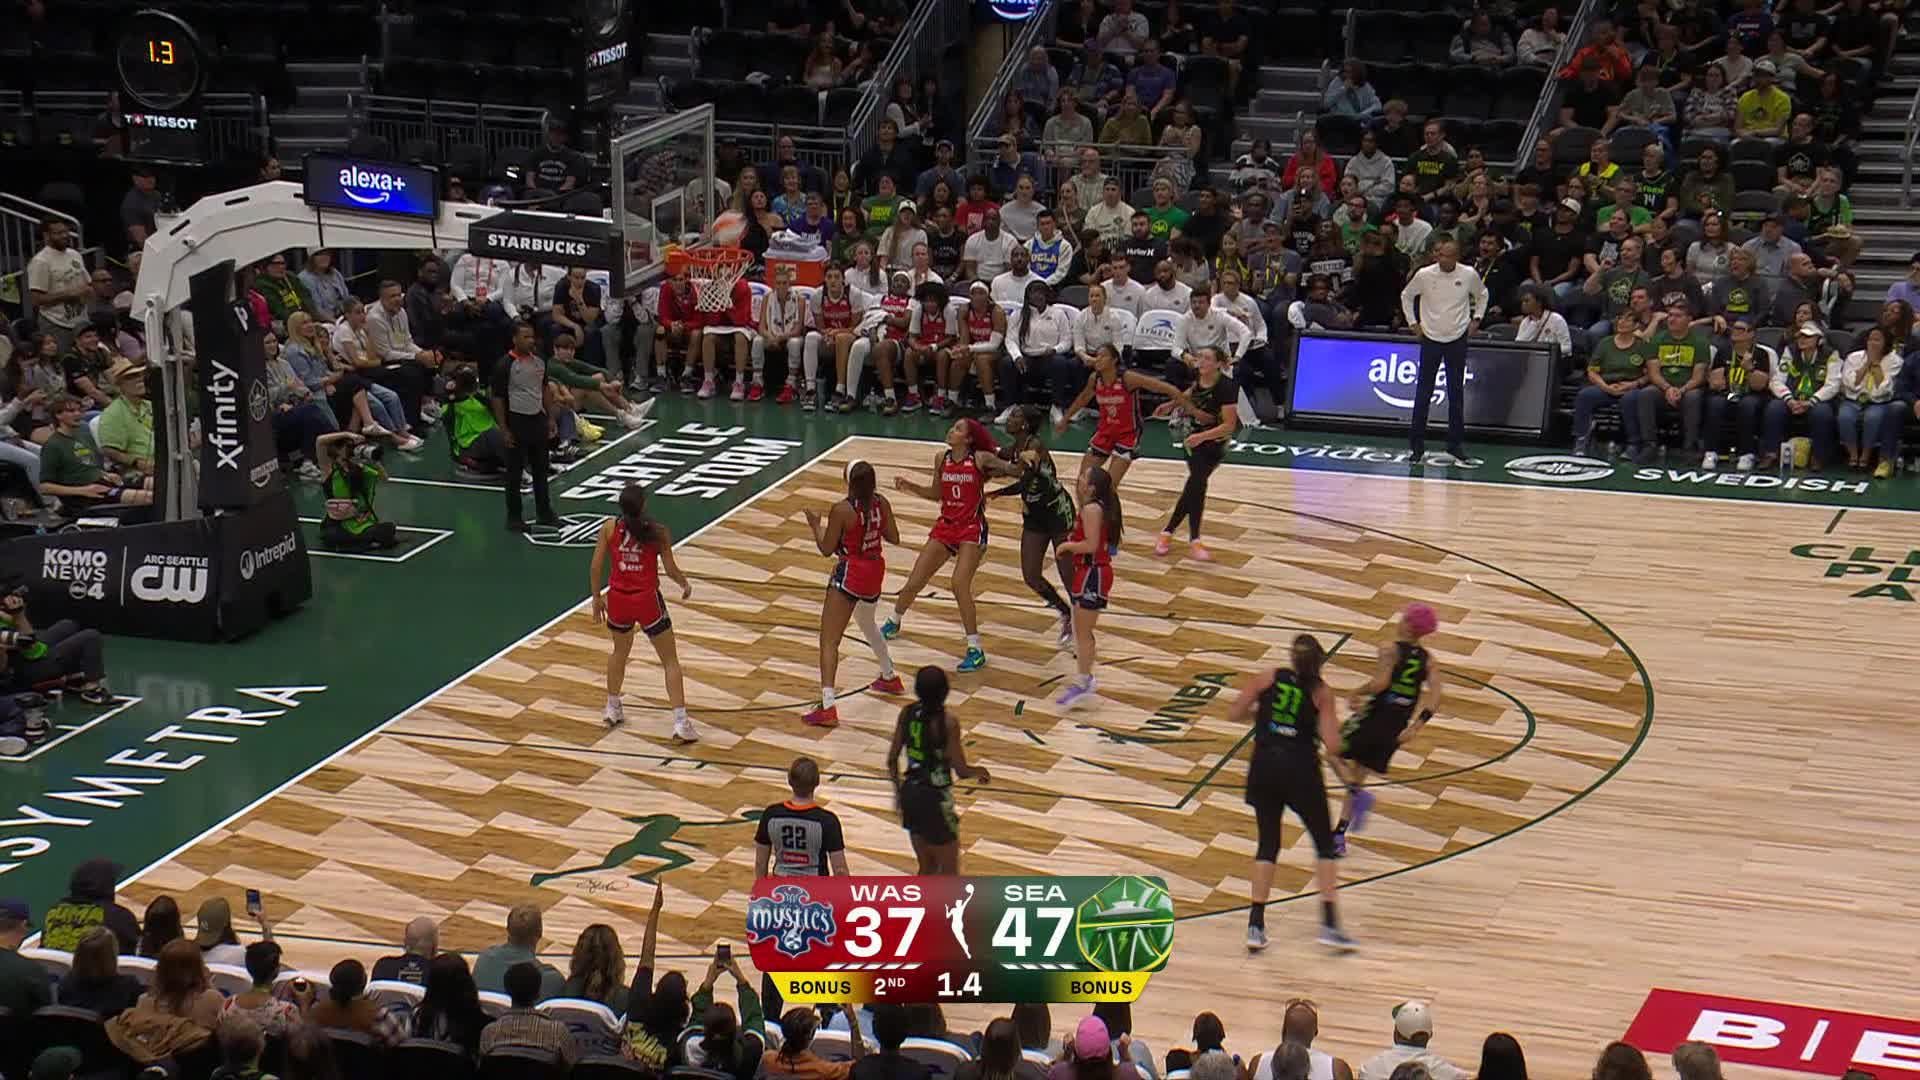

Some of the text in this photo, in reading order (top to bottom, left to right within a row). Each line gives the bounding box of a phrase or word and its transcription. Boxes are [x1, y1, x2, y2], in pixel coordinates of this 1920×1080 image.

[149, 41, 174, 64] 1.3
[598, 42, 627, 66] TISSOT
[144, 114, 197, 130] TISSOT
[339, 165, 406, 191] alexa+
[487, 234, 587, 256] STARBUCKS
[1031, 253, 1057, 263] UCLA
[1141, 327, 1175, 338] SYMET
[1368, 353, 1475, 386] alea+
[206, 360, 244, 470] xfinity
[560, 422, 746, 503] SEATTLE
[1173, 438, 1485, 468] rovidece
[655, 437, 803, 499] STORM
[951, 484, 962, 499] 0
[1633, 468, 1869, 494] SWEDISH
[43, 548, 108, 566] KOMO
[143, 554, 209, 567] ARC SEATTLE
[254, 532, 296, 569] Intrepid
[42, 565, 106, 582] NEWS
[130, 565, 209, 604] CW
[87, 582, 105, 600] 4
[1401, 658, 1422, 684] 2
[1136, 671, 1239, 733] WNBA
[1272, 682, 1304, 718] 31
[781, 825, 808, 850] 22
